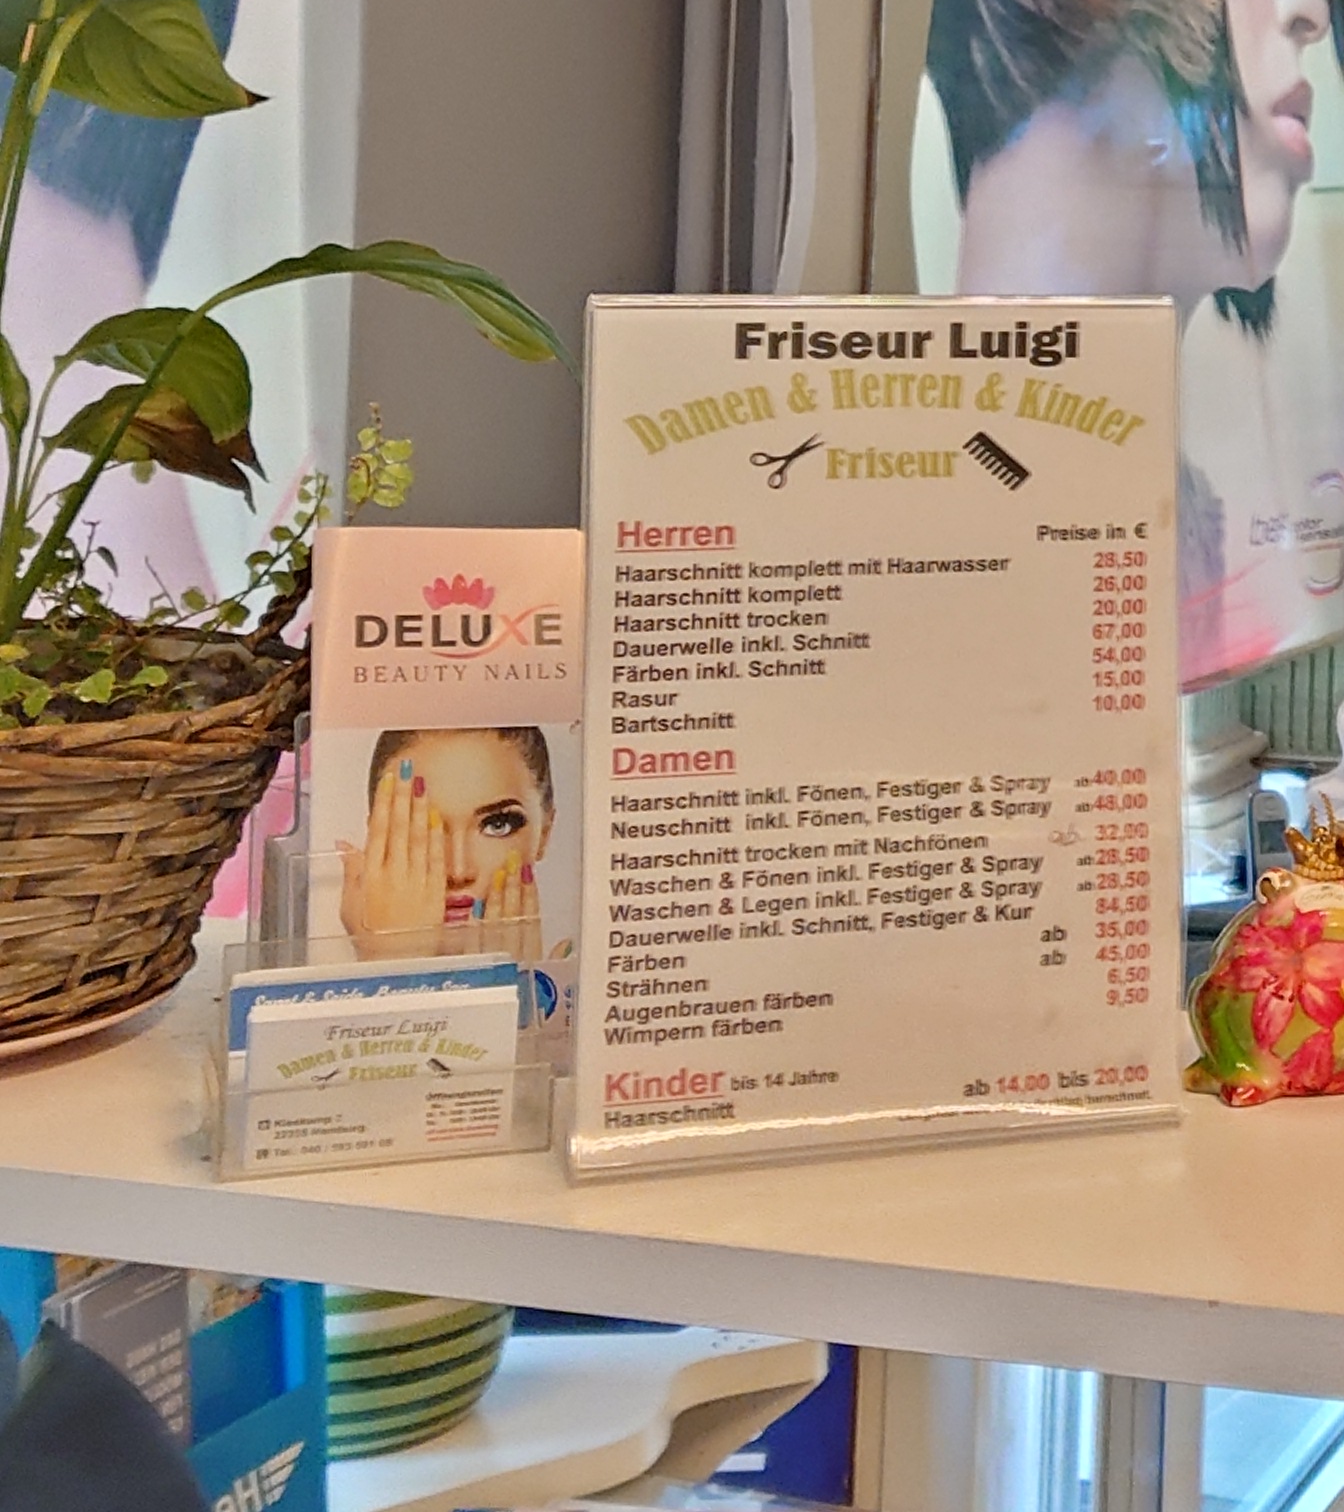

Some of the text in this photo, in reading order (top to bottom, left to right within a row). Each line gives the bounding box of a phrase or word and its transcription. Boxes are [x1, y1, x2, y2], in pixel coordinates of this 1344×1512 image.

[734, 320, 1080, 367] Friseur Luigi
[624, 367, 1146, 455] Damen & Herren & Kinder
[825, 445, 960, 480] Friseur
[616, 521, 736, 548] Herren
[1036, 522, 1148, 543] Preise in €
[615, 555, 1010, 583] Haarschnitt komplett mit Haarwasser
[1092, 551, 1146, 570] 28,50
[614, 583, 843, 608] Haarschnitt komplett
[1092, 575, 1146, 594] 26,00
[1092, 598, 1146, 618] 20,00
[354, 610, 563, 654] DELUXE
[613, 609, 829, 633] Haarschnitt trocken
[1092, 622, 1146, 642] 67,00
[612, 631, 871, 658] Dauerwelle inkl. Schnitt
[1092, 646, 1146, 665] 54,00
[353, 662, 568, 684] BEAUTY NAILS
[612, 657, 826, 683] Färben inkl. Schnitt
[1092, 669, 1146, 688] 15,00
[611, 689, 679, 708] Rasur
[1092, 693, 1146, 713] 10,00
[611, 713, 736, 734] Bartschnitt
[611, 745, 736, 776] Damen
[1092, 769, 1146, 788] 40,00
[610, 773, 1052, 814] Haarschnitt inkl. Fönen, Festiger & Spray
[1092, 794, 1147, 813] 48,00
[610, 798, 1053, 840] Neuschnitt inkl. Fönen, Festiger & Spray
[1094, 823, 1149, 843] 32,00
[610, 833, 989, 872] Haarschnitt trocken mit Nachfönen
[1094, 846, 1149, 866] 28,50
[609, 854, 1044, 898] Waschen & Fönen inkl. Festiger & Spray
[1094, 871, 1150, 892] 28,50
[609, 878, 1043, 924] Waschen & Legen inkl. Festiger & Spray
[1095, 896, 1150, 916] 84,50
[608, 902, 1034, 950] Dauerwelle inkl. Schnitt, Festiger & Kur
[607, 920, 1150, 974] Färben ab 35,00
[605, 944, 1150, 999] Strähnen ab 45,00
[1107, 967, 1150, 987] 6,50
[604, 997, 756, 1027] Augenbrauen
[762, 990, 834, 1013] färben
[324, 1016, 448, 1040] Friseur Luigi
[603, 1016, 782, 1047] Wimpern färben
[277, 1036, 488, 1078] Damen & Herren & Kinder
[349, 1062, 416, 1080] Friseur
[603, 1068, 725, 1102] Kinder
[730, 1075, 758, 1092] bis
[763, 1073, 783, 1087] 14
[788, 1069, 839, 1086] Jahre
[964, 1081, 990, 1098] ab
[1058, 1069, 1088, 1088] bis
[1094, 1065, 1149, 1087] 20,00
[603, 1102, 735, 1129] Haarschnitt
